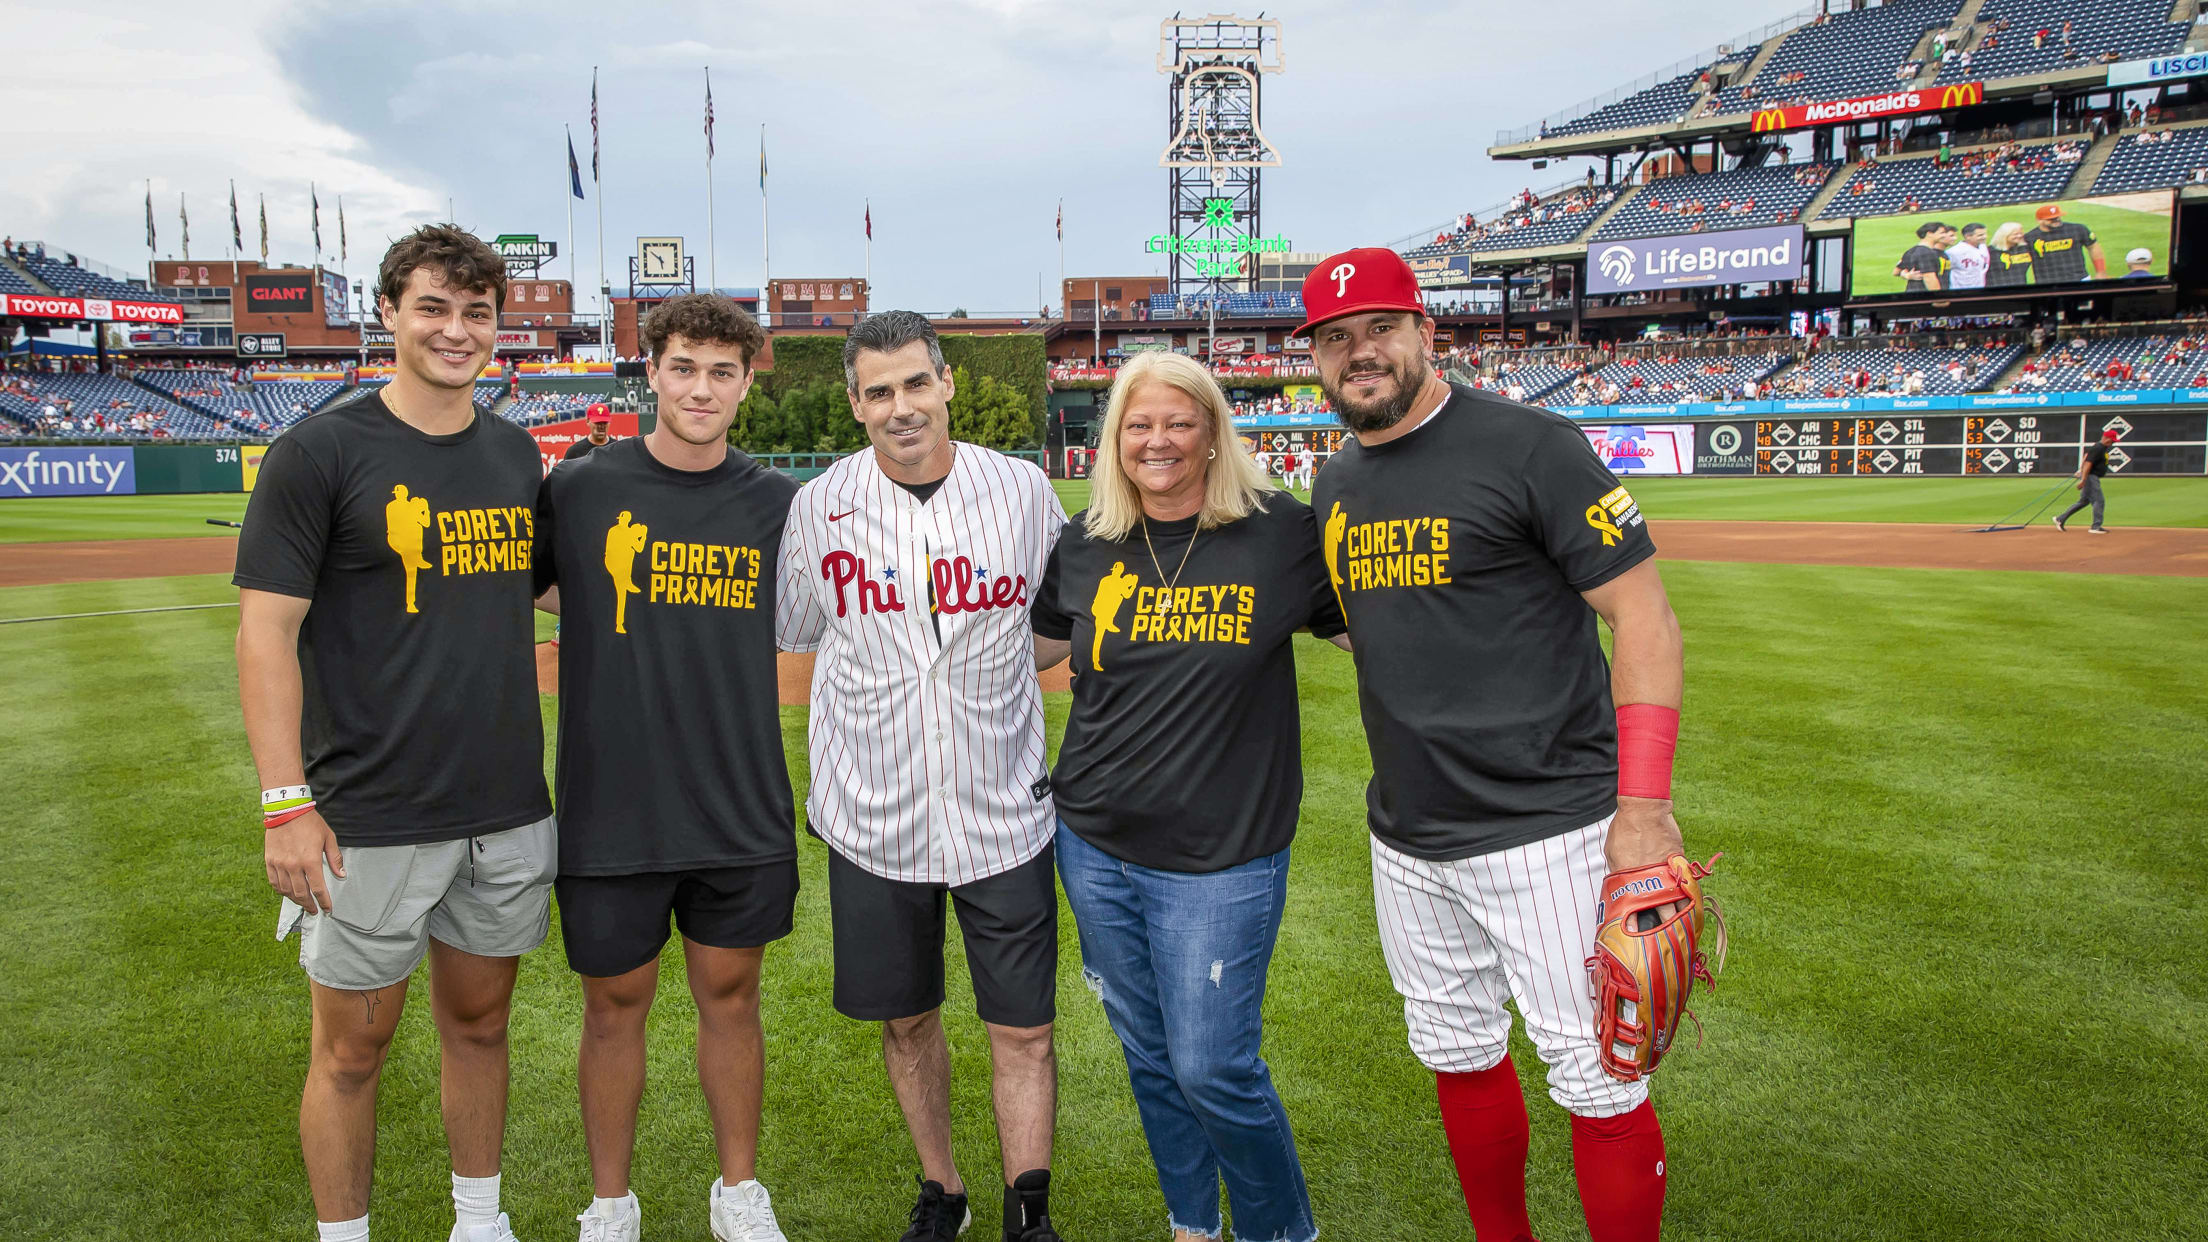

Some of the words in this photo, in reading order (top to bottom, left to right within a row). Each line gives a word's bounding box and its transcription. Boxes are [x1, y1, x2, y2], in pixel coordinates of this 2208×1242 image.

[1805, 93, 1921, 122] McDonald's
[1149, 235, 1232, 253] Citizens
[1237, 234, 1290, 253] Bank
[1645, 238, 1790, 275] LifeBrand
[1196, 258, 1241, 276] Park
[1330, 263, 1356, 298] P
[252, 287, 307, 300] GIANT
[11, 299, 81, 315] TOYOTA
[116, 304, 180, 320] TOYOTA
[1758, 422, 1772, 433] 37
[1801, 421, 1820, 433] ARI
[1832, 421, 1839, 432] 3
[1903, 419, 1926, 431] STL
[2019, 417, 2036, 429] SD
[1290, 431, 1304, 441] MIL
[1312, 432, 1318, 440] 2
[1720, 434, 1733, 446] R
[1798, 434, 1821, 446] CHC
[1831, 435, 1839, 445] 2
[1904, 432, 1925, 444] CIN
[2014, 431, 2041, 443] HOU
[1593, 438, 1655, 459] Phillies
[1798, 450, 1820, 460] LAD
[1904, 448, 1923, 460] PIT
[2014, 447, 2039, 459] COL
[215, 449, 238, 462] 374
[1697, 455, 1753, 463] ROTHMAN
[0, 451, 126, 492] xfinity
[1796, 463, 1822, 473] WSH
[1902, 462, 1924, 474] ATL
[2017, 461, 2034, 473] SF
[437, 506, 533, 543] COREY'S
[1347, 518, 1449, 558] COREY'S
[651, 541, 761, 578] COREY'S
[1136, 585, 1255, 615] COREY'S
[1611, 877, 1663, 901] Wilson
